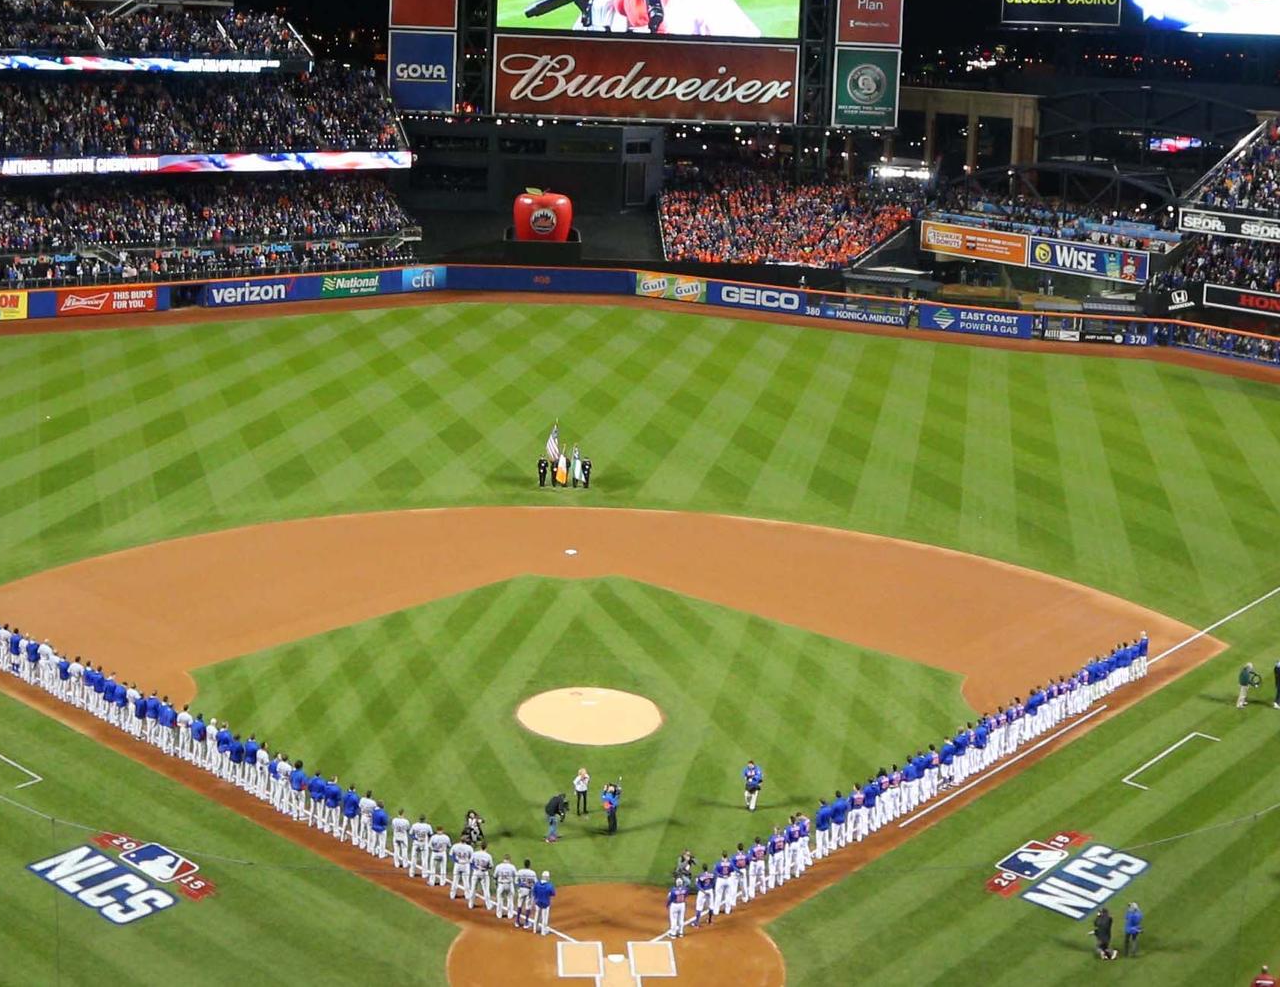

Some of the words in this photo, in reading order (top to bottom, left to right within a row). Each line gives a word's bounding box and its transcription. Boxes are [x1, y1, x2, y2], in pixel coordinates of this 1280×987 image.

[396, 64, 446, 79] GOYA
[500, 54, 792, 104] Budweiser
[336, 276, 379, 289] National
[412, 272, 434, 288] citi
[642, 280, 666, 294] Gulf
[113, 292, 130, 300] THIS
[131, 290, 152, 299] BUD'S
[212, 282, 286, 304] verizon
[676, 284, 699, 296] Gulf
[721, 285, 800, 310] GEICO
[112, 300, 128, 309] FOR
[128, 300, 146, 308] YOU.
[806, 306, 820, 317] 380
[1168, 302, 1195, 310] HONDA
[836, 310, 868, 322] KONICA
[869, 314, 904, 325] MINOLTA
[960, 312, 984, 322] EAST
[986, 313, 1018, 324] COAST
[960, 321, 989, 332] POWER
[990, 324, 998, 332] &
[999, 324, 1018, 334] GAS
[1129, 335, 1147, 345] 370
[111, 836, 137, 851] 20
[1050, 834, 1071, 850] 15
[28, 844, 175, 924] NLCS
[180, 875, 206, 890] 15
[994, 872, 1018, 888] 20
[1021, 844, 1150, 920] NLCS
